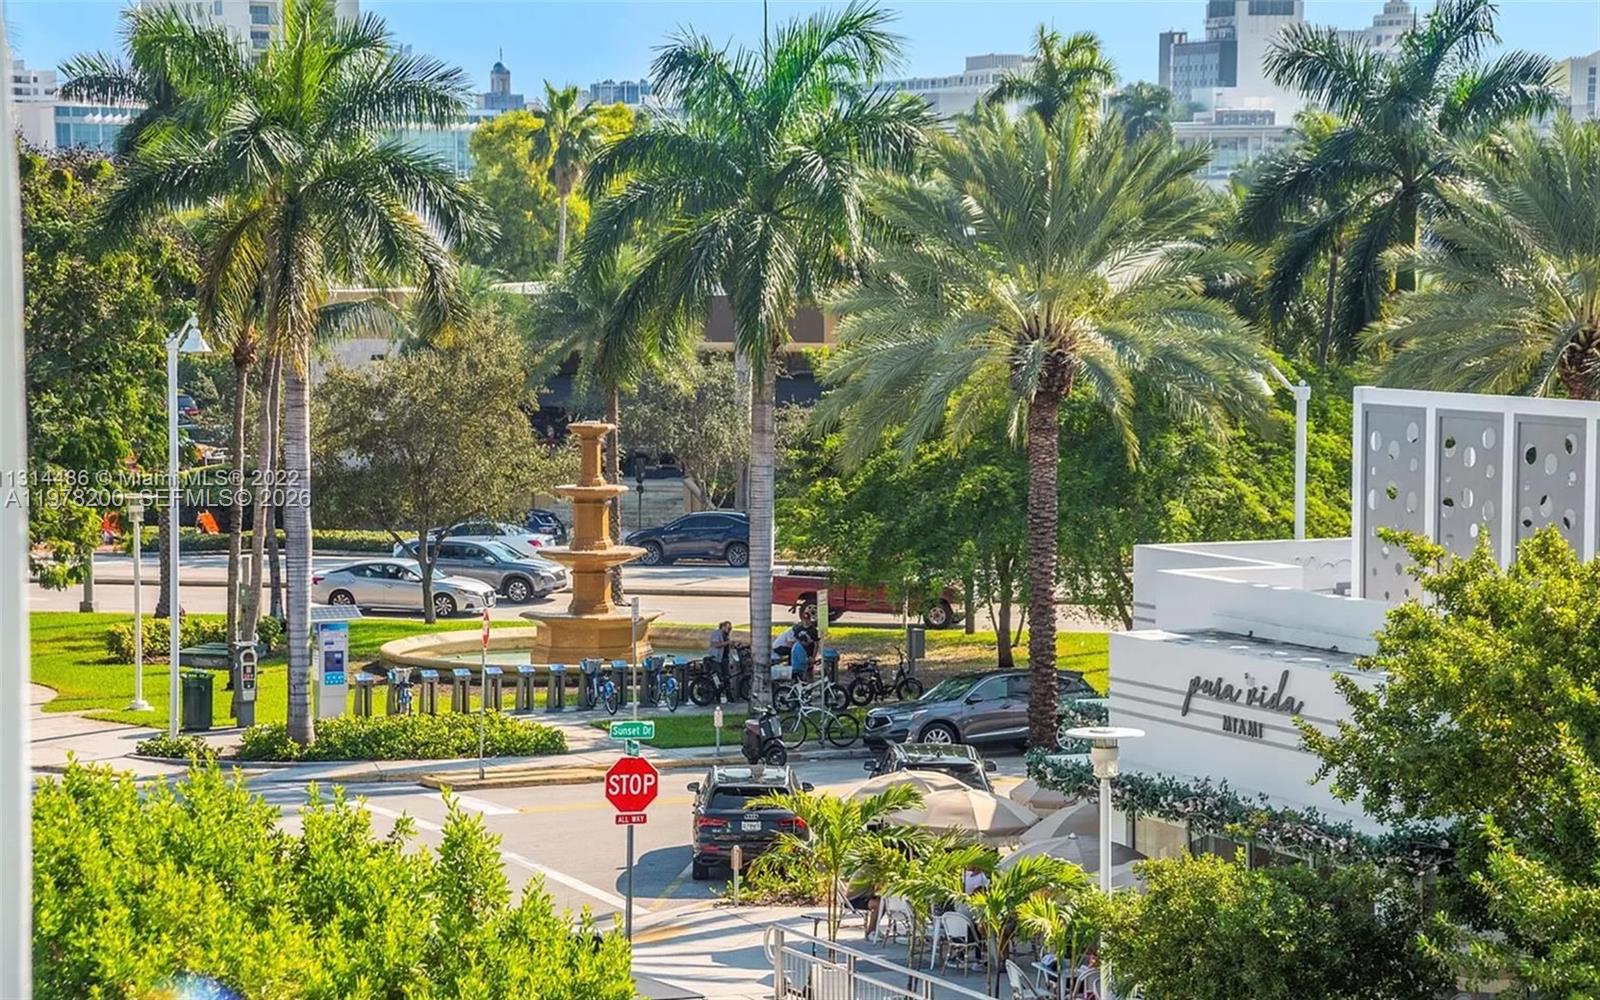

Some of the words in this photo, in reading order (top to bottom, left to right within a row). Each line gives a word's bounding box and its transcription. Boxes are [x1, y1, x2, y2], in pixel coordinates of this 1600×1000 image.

[1181, 675, 1242, 717] pura
[1246, 669, 1305, 715] vida
[612, 726, 640, 736] Sunset
[642, 726, 652, 736] Dr
[1222, 715, 1264, 739] MIAMI
[608, 773, 656, 796] STOP
[617, 815, 629, 823] ALL
[631, 815, 645, 823] WAY
